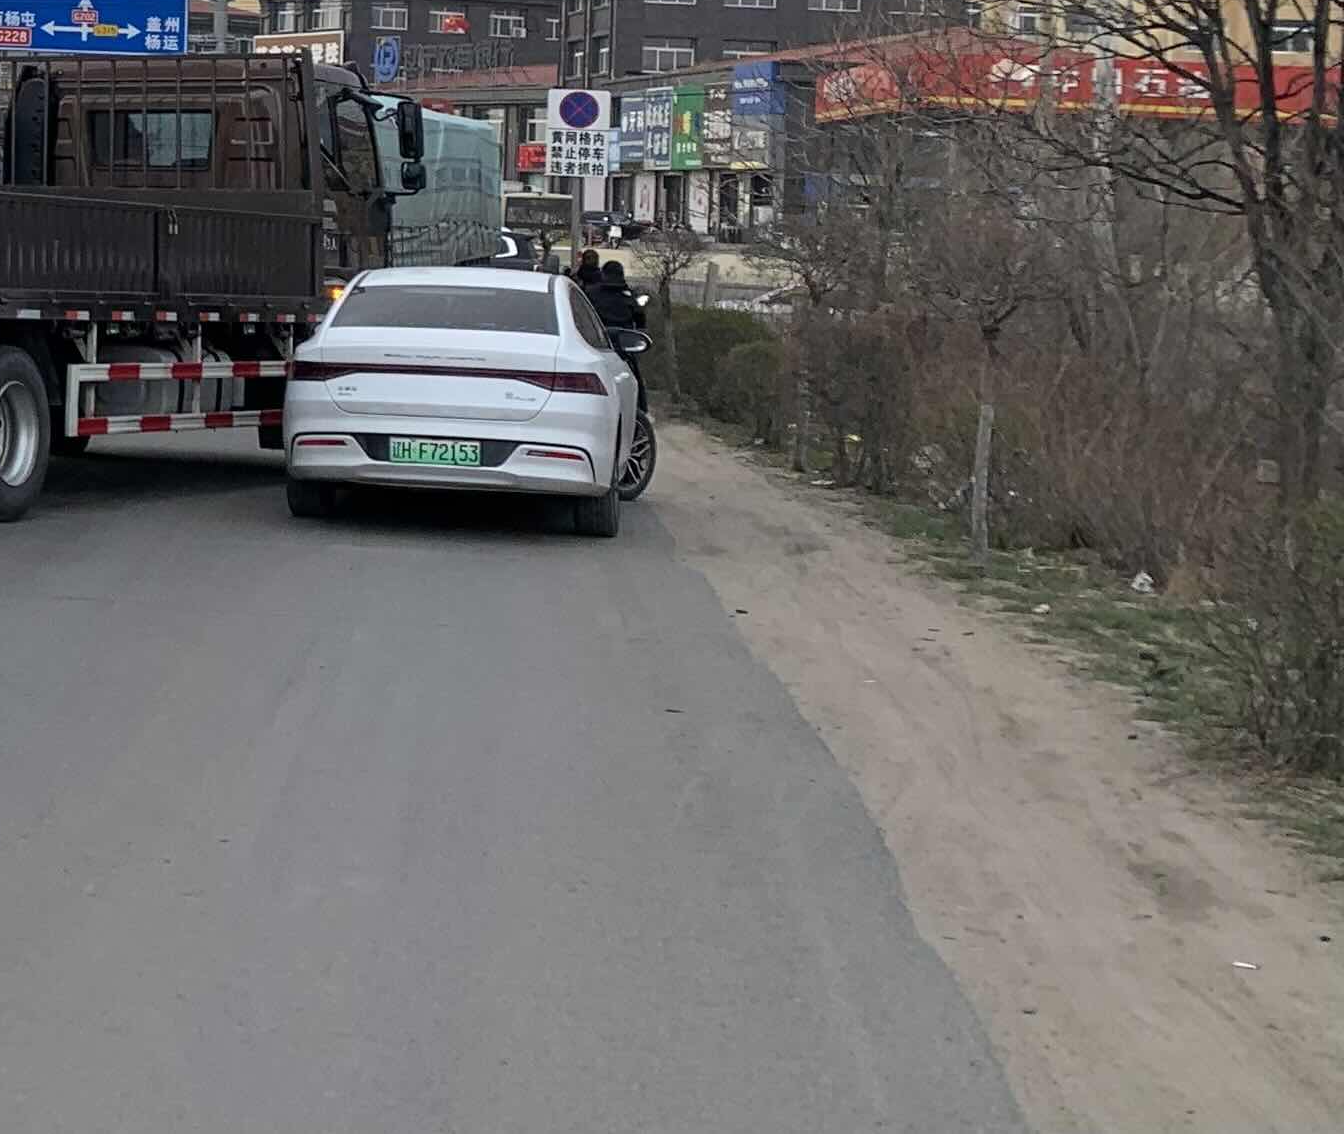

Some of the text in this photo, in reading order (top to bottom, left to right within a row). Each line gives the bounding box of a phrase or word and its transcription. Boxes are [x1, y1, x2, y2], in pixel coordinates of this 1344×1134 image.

[145, 16, 180, 34] 盖州
[144, 34, 179, 51] 杨运
[551, 146, 605, 161] 禁止停车
